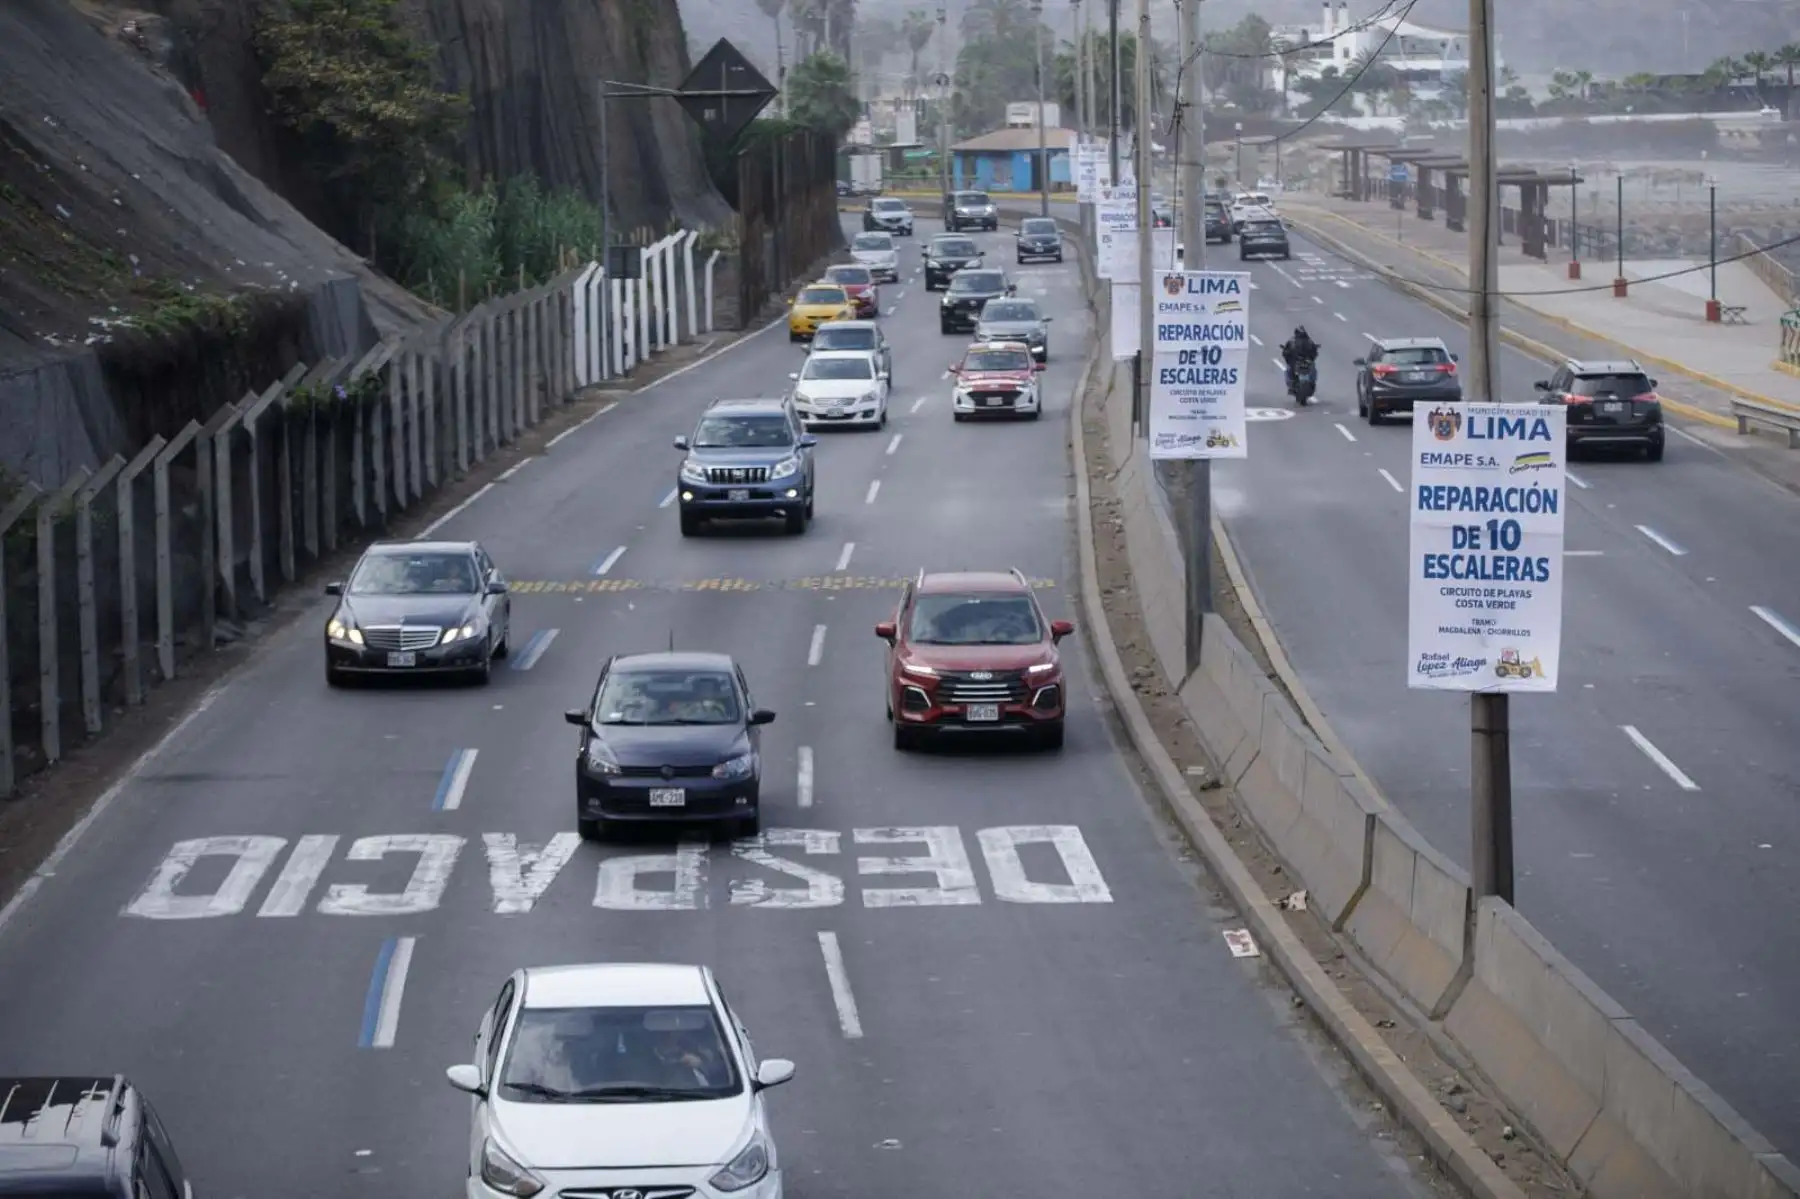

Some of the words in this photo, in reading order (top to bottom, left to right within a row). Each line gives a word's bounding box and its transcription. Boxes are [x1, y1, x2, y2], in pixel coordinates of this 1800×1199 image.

[1188, 279, 1240, 294] LIMA
[1159, 303, 1193, 312] EMAPE
[1158, 320, 1244, 341] REPARACIÓN
[1179, 349, 1197, 365] DE
[1200, 345, 1222, 365] 10
[1160, 368, 1238, 385] ESCALERAS
[1467, 416, 1552, 441] LIMA
[1420, 452, 1473, 465] EMAPE
[1476, 456, 1500, 467] S.A.
[1418, 481, 1558, 514] REPARACIÓN
[1452, 525, 1481, 550] DE
[1486, 519, 1522, 551] 10
[1424, 553, 1550, 582] ESCALERAS
[1440, 587, 1482, 597] CIRCUITO
[1483, 588, 1496, 598] DE
[1497, 588, 1532, 599] PLAYAS
[1455, 599, 1484, 608] COSTA
[1486, 600, 1516, 610] VERDE
[1472, 618, 1496, 626] TRAMO
[1438, 626, 1482, 635] MAGDALENA
[1487, 627, 1531, 637] CHORRILLOS
[1421, 652, 1450, 661] Rafael
[1452, 657, 1487, 672] Aliaga
